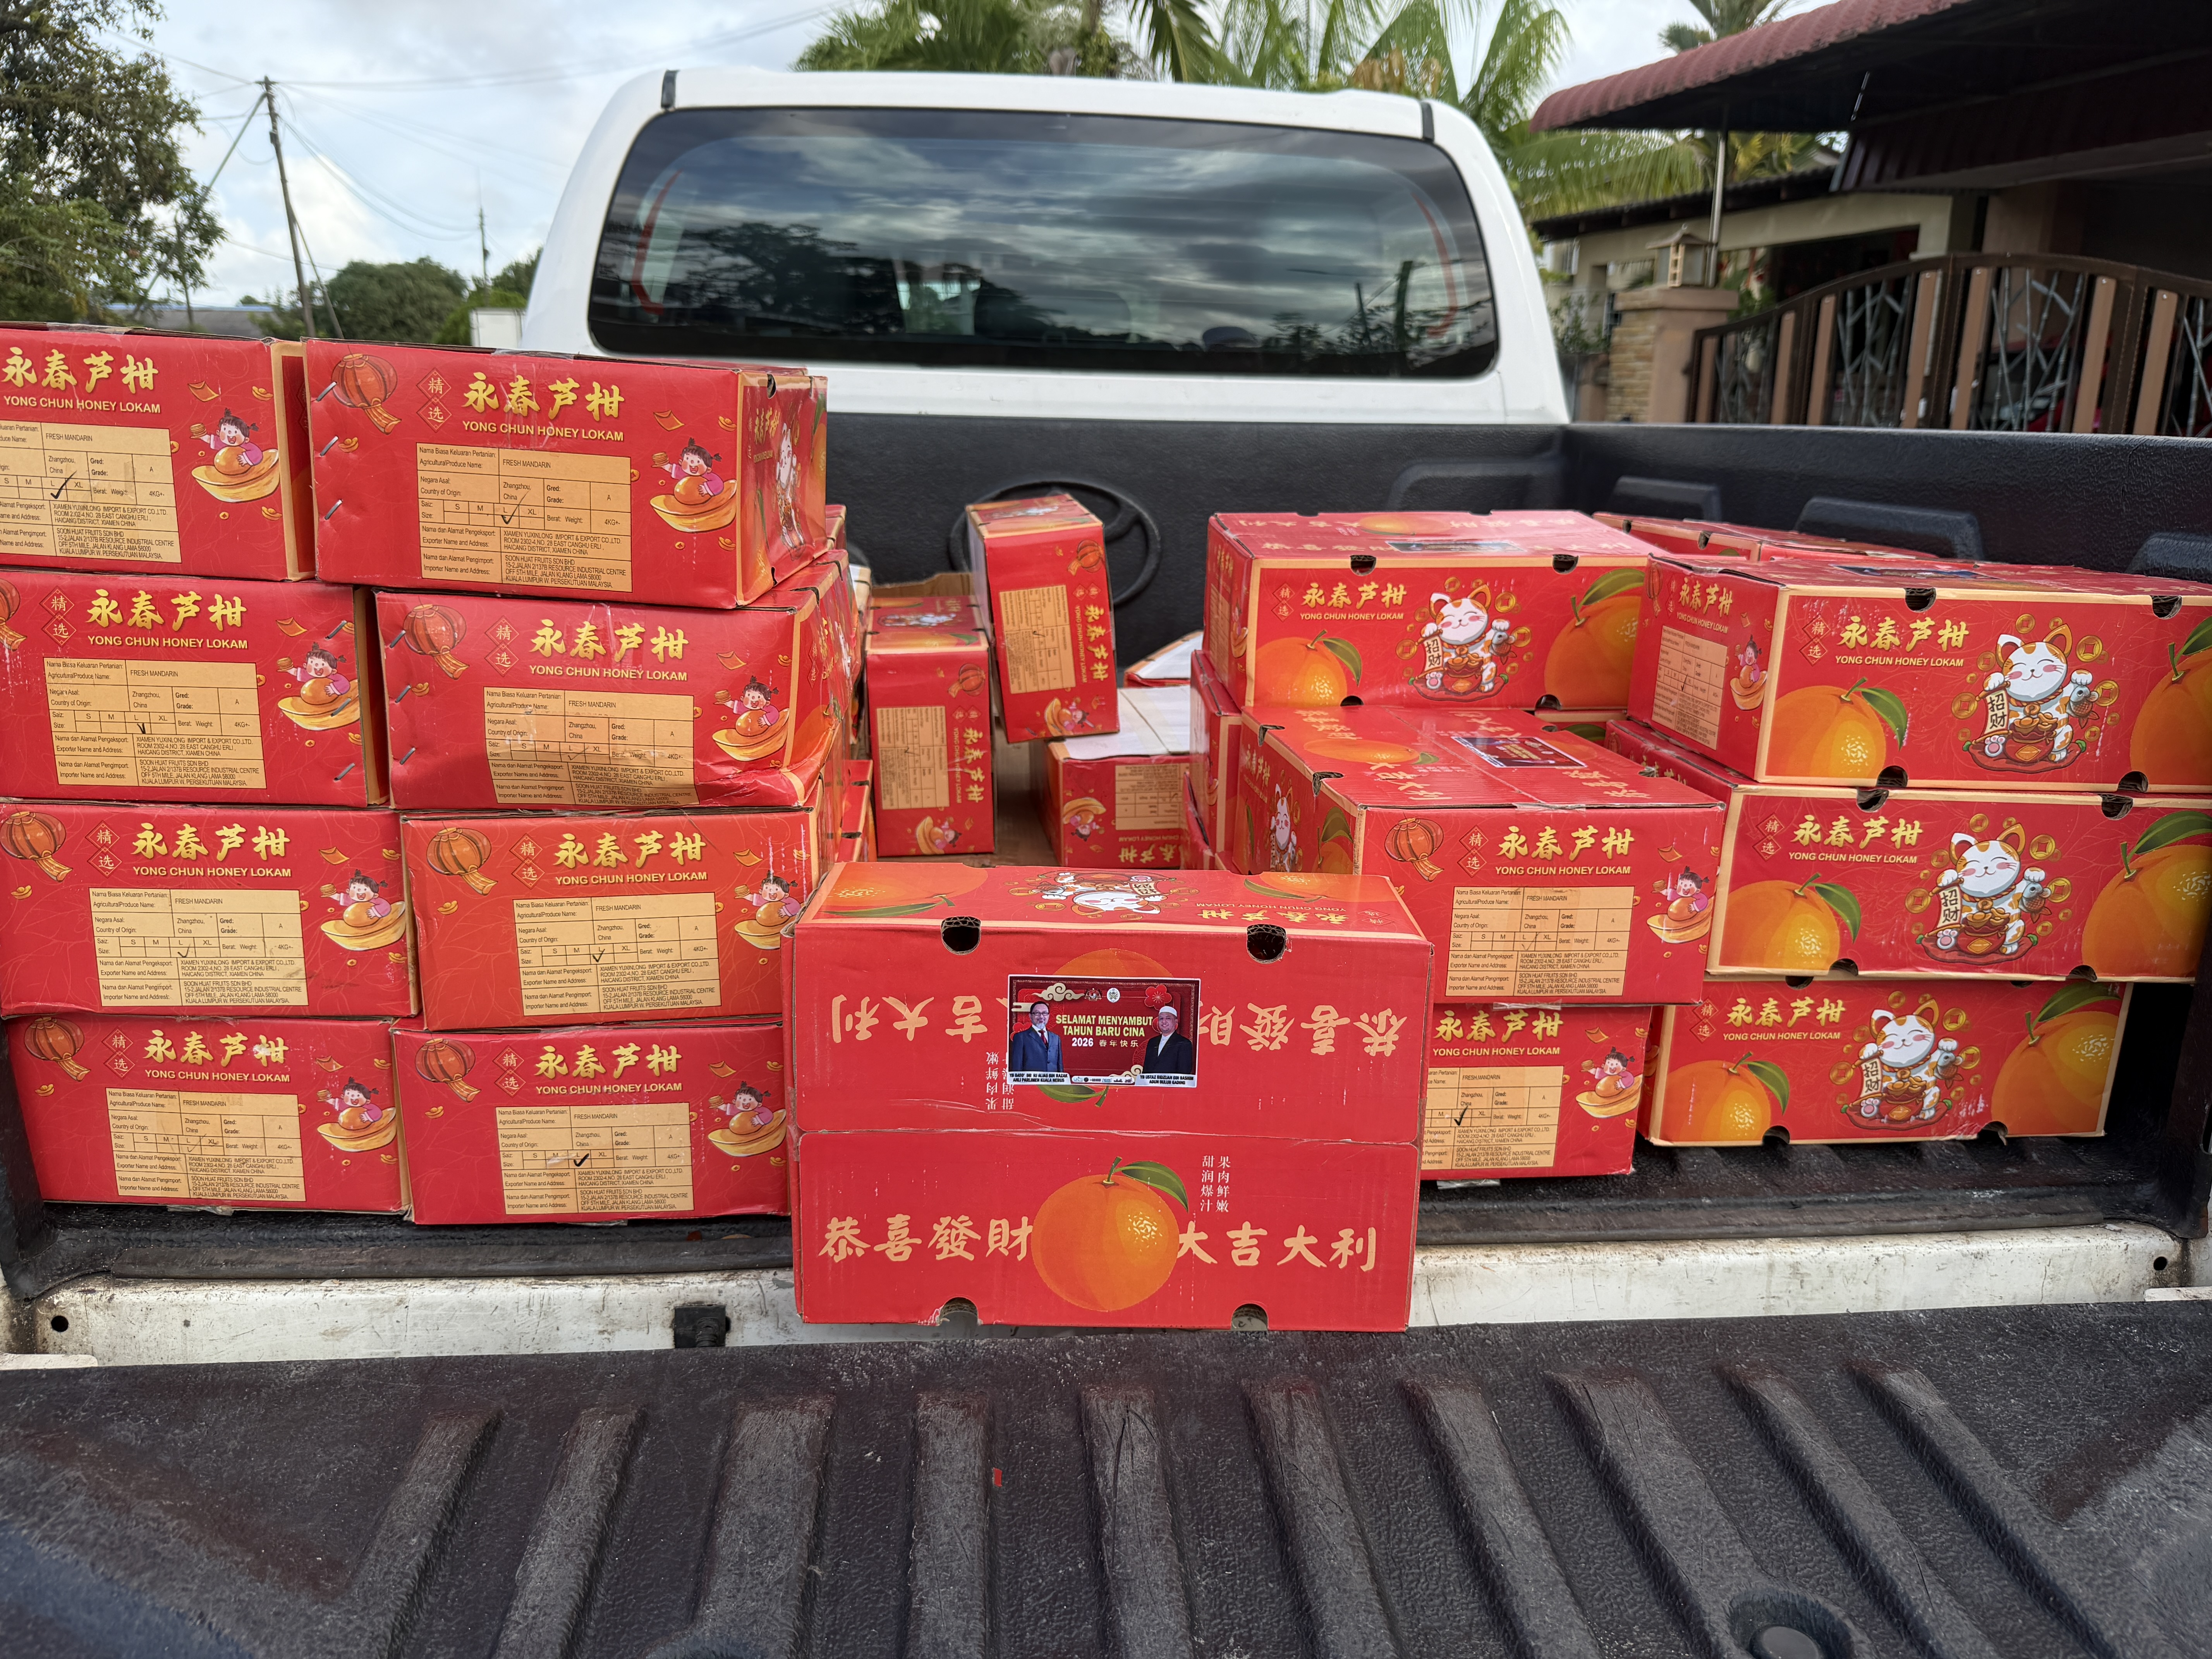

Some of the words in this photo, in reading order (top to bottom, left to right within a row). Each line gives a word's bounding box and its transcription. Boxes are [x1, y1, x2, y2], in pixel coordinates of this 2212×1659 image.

[2, 347, 159, 393] 永春芦柑
[3, 395, 37, 407] YONG
[40, 397, 73, 409] CHUN
[76, 398, 117, 412] HONEY
[120, 402, 160, 413] LOKAM
[462, 372, 625, 421] 永春芦柑
[462, 421, 496, 432] YONG
[500, 423, 534, 434] CHUN
[538, 425, 579, 438] HONEY
[582, 429, 623, 441] LOKAM
[86, 589, 247, 631] 永春芦柑
[1302, 581, 1407, 609] 永春芦柑
[1679, 577, 1732, 617] 永春芦柑
[1677, 611, 1686, 621] YONG
[1687, 615, 1697, 625] CHUN
[1698, 619, 1713, 629] HONEY
[1714, 623, 1728, 634] LOKAM
[1838, 615, 1969, 652] 永春芦柑
[88, 635, 122, 645] YONG
[125, 637, 159, 646] CHUN
[163, 637, 203, 647] HONEY
[206, 639, 247, 649] LOKAM
[529, 619, 689, 663] 永春芦柑
[1084, 604, 1109, 681] 永春芦柑
[1426, 639, 1441, 666] 招财
[529, 665, 563, 675] YONG
[566, 666, 600, 677] CHUN
[602, 668, 644, 679] HONEY
[646, 670, 687, 681] LOKAM
[1835, 656, 1863, 664] YONG
[1865, 656, 1893, 665] CHUN
[1895, 657, 1929, 666] HONEY
[1930, 658, 1964, 666] LOKAM
[1988, 693, 2007, 728] 招财
[131, 823, 290, 861] 永春芦柑
[1497, 825, 1635, 860] 永春芦柑
[1792, 814, 1923, 849] 永春芦柑
[553, 831, 706, 868] 永春芦柑
[1789, 852, 1816, 860] YONG
[1818, 853, 1846, 861] CHUN
[1848, 854, 1882, 862] HONEY
[1883, 855, 1917, 864] LOKAM
[133, 866, 167, 876] YONG
[170, 867, 204, 876] CHUN
[207, 867, 248, 876] HONEY
[251, 868, 291, 877] LOKAM
[555, 876, 588, 885] YONG
[591, 874, 623, 884] CHUN
[626, 873, 665, 882] HONEY
[668, 872, 707, 881] LOKAM
[1495, 866, 1524, 874] YONG
[1559, 866, 1594, 874] HONEY
[1595, 866, 1631, 874] LOKAM
[1197, 909, 1349, 924] 永春芦柑
[1941, 889, 1960, 923] 招财
[832, 994, 1008, 1043] 吉大利
[1056, 1015, 1096, 1024] SELAMAT
[1098, 1015, 1153, 1025] MENYAMBUT
[1434, 1010, 1564, 1042] 永春芦柑
[1726, 996, 1846, 1027] 永春芦柑
[1063, 1025, 1093, 1036] TAHUN
[1096, 1027, 1120, 1036] BARU
[1123, 1027, 1145, 1037] CINA
[1072, 1037, 1094, 1047] 2026
[143, 1029, 289, 1066] 永春芦柑
[534, 1043, 682, 1079] 永春芦柑
[1492, 1047, 1525, 1055] HONEY
[1527, 1047, 1560, 1055] LOKAM
[145, 1069, 175, 1079] YONG
[178, 1071, 209, 1080] CHUN
[212, 1072, 249, 1081] HONEY
[252, 1073, 290, 1082] LOKAM
[536, 1086, 567, 1094] YONG
[570, 1085, 601, 1095] CHUN
[603, 1084, 642, 1094] HONEY
[643, 1083, 682, 1093] LOKAM
[1864, 1061, 1881, 1092] 招财
[1200, 1155, 1215, 1212] 甜润爆汁
[1215, 1156, 1231, 1212] 果肉鲜嫩
[818, 1213, 1033, 1263] 恭喜發財
[1176, 1220, 1376, 1272] 大吉大利
